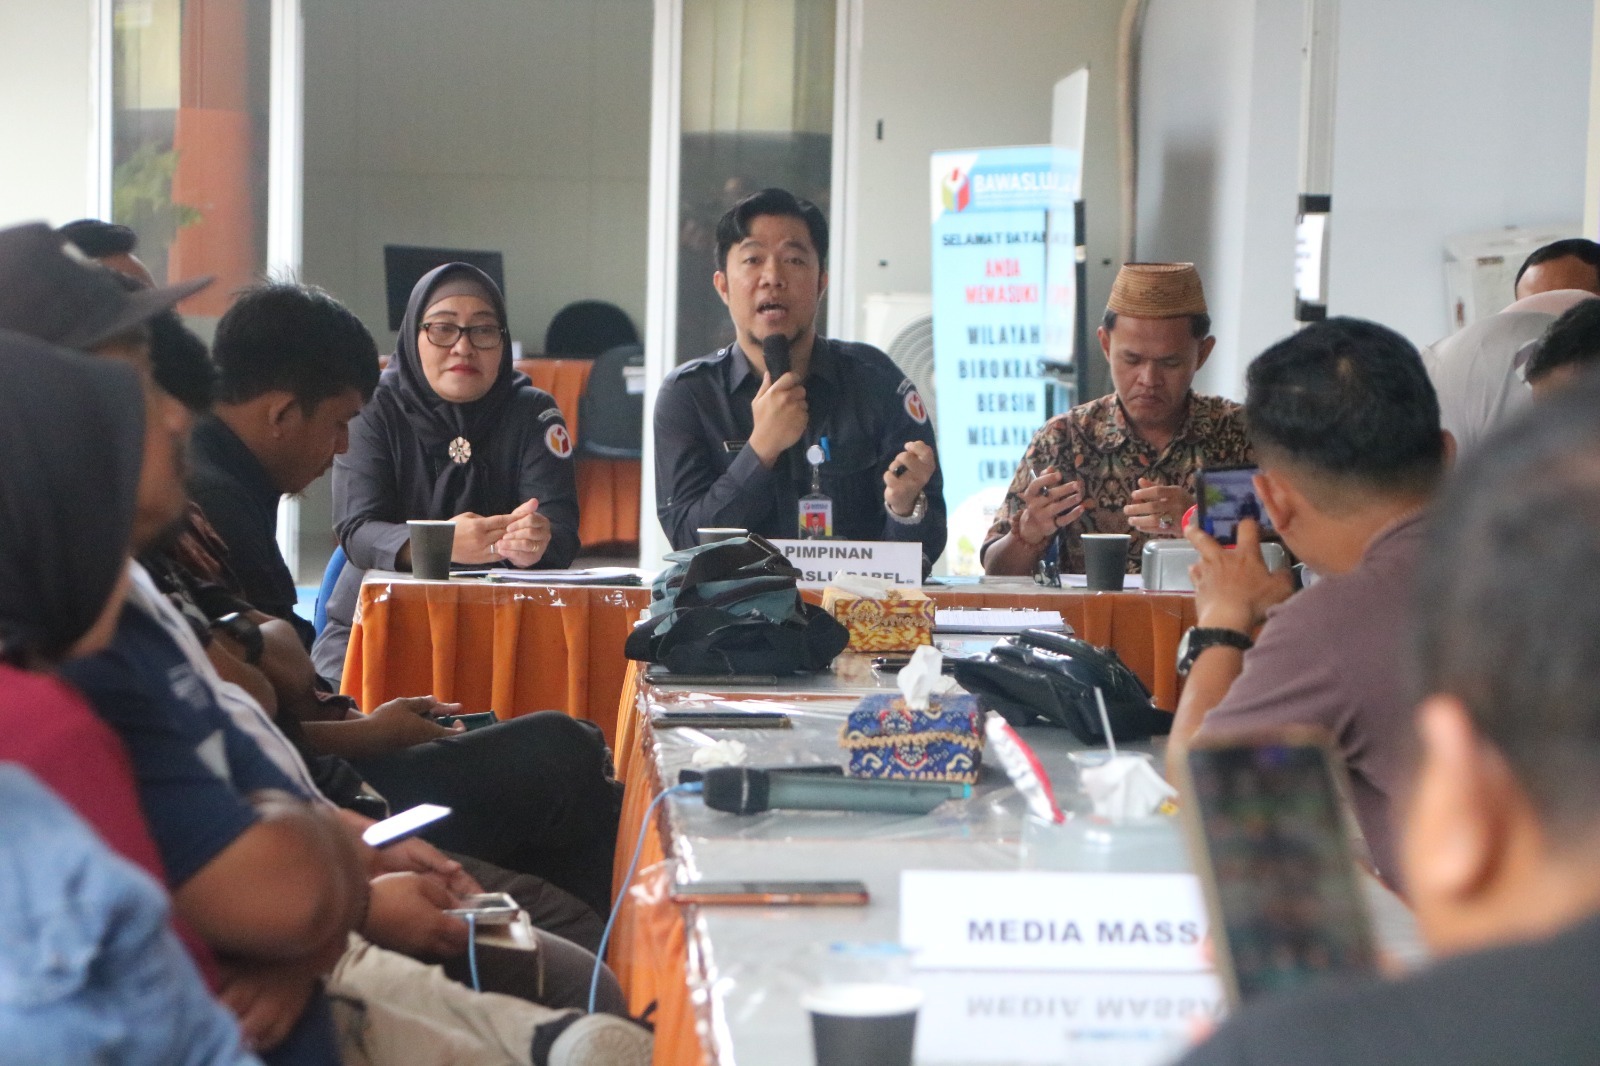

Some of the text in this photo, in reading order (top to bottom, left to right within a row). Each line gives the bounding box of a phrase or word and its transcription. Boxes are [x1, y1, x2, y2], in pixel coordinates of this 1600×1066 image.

[943, 231, 1047, 246] SELAMAT DATA
[986, 258, 1020, 277] ANDA
[965, 284, 1039, 303] MEMASUKI
[967, 325, 1040, 345] WILAYAH
[958, 359, 1046, 379] BIROKRAS
[977, 393, 1036, 412] BERSIH
[968, 426, 1037, 446] MELAYA
[785, 546, 873, 559] PIMPINAN
[968, 920, 1200, 944] MEDIA MASS
